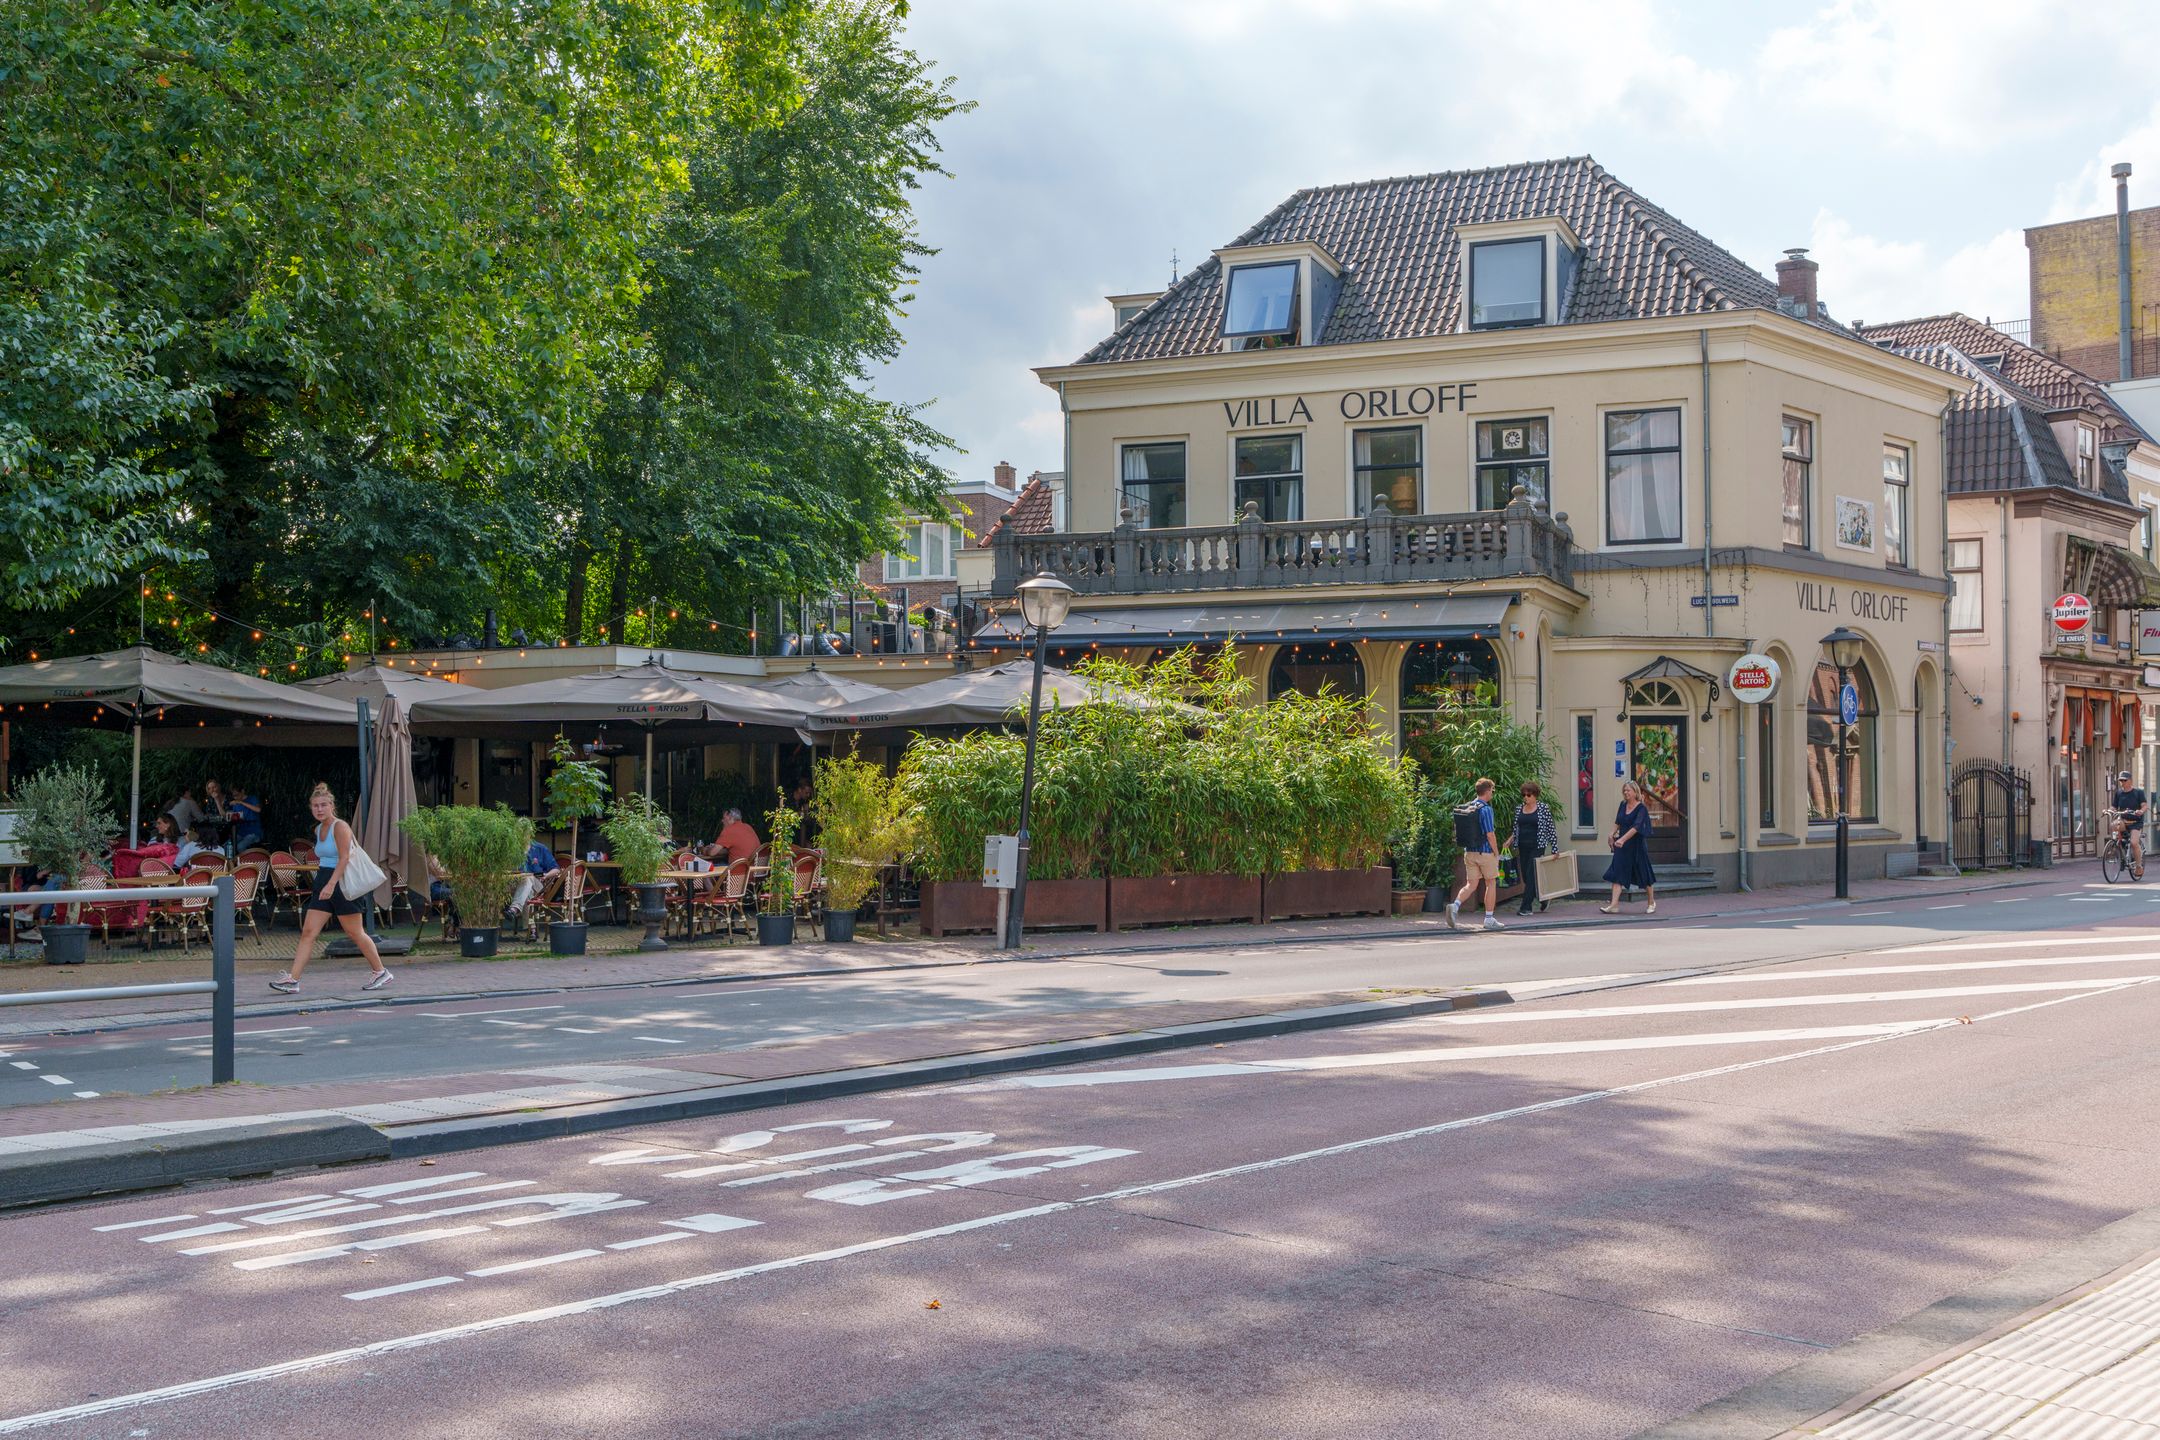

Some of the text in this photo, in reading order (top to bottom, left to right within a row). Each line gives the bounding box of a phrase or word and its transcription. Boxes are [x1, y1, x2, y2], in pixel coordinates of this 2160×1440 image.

[1224, 383, 1477, 428] VILLA ORLOFF
[1796, 581, 1908, 622] VILLA ORLOFF
[2054, 607, 2089, 618] Jupiler
[2066, 634, 2085, 642] KNEUS
[616, 704, 689, 713] STELLA ARTOIS
[819, 714, 889, 724] STELLA ARTOIS
